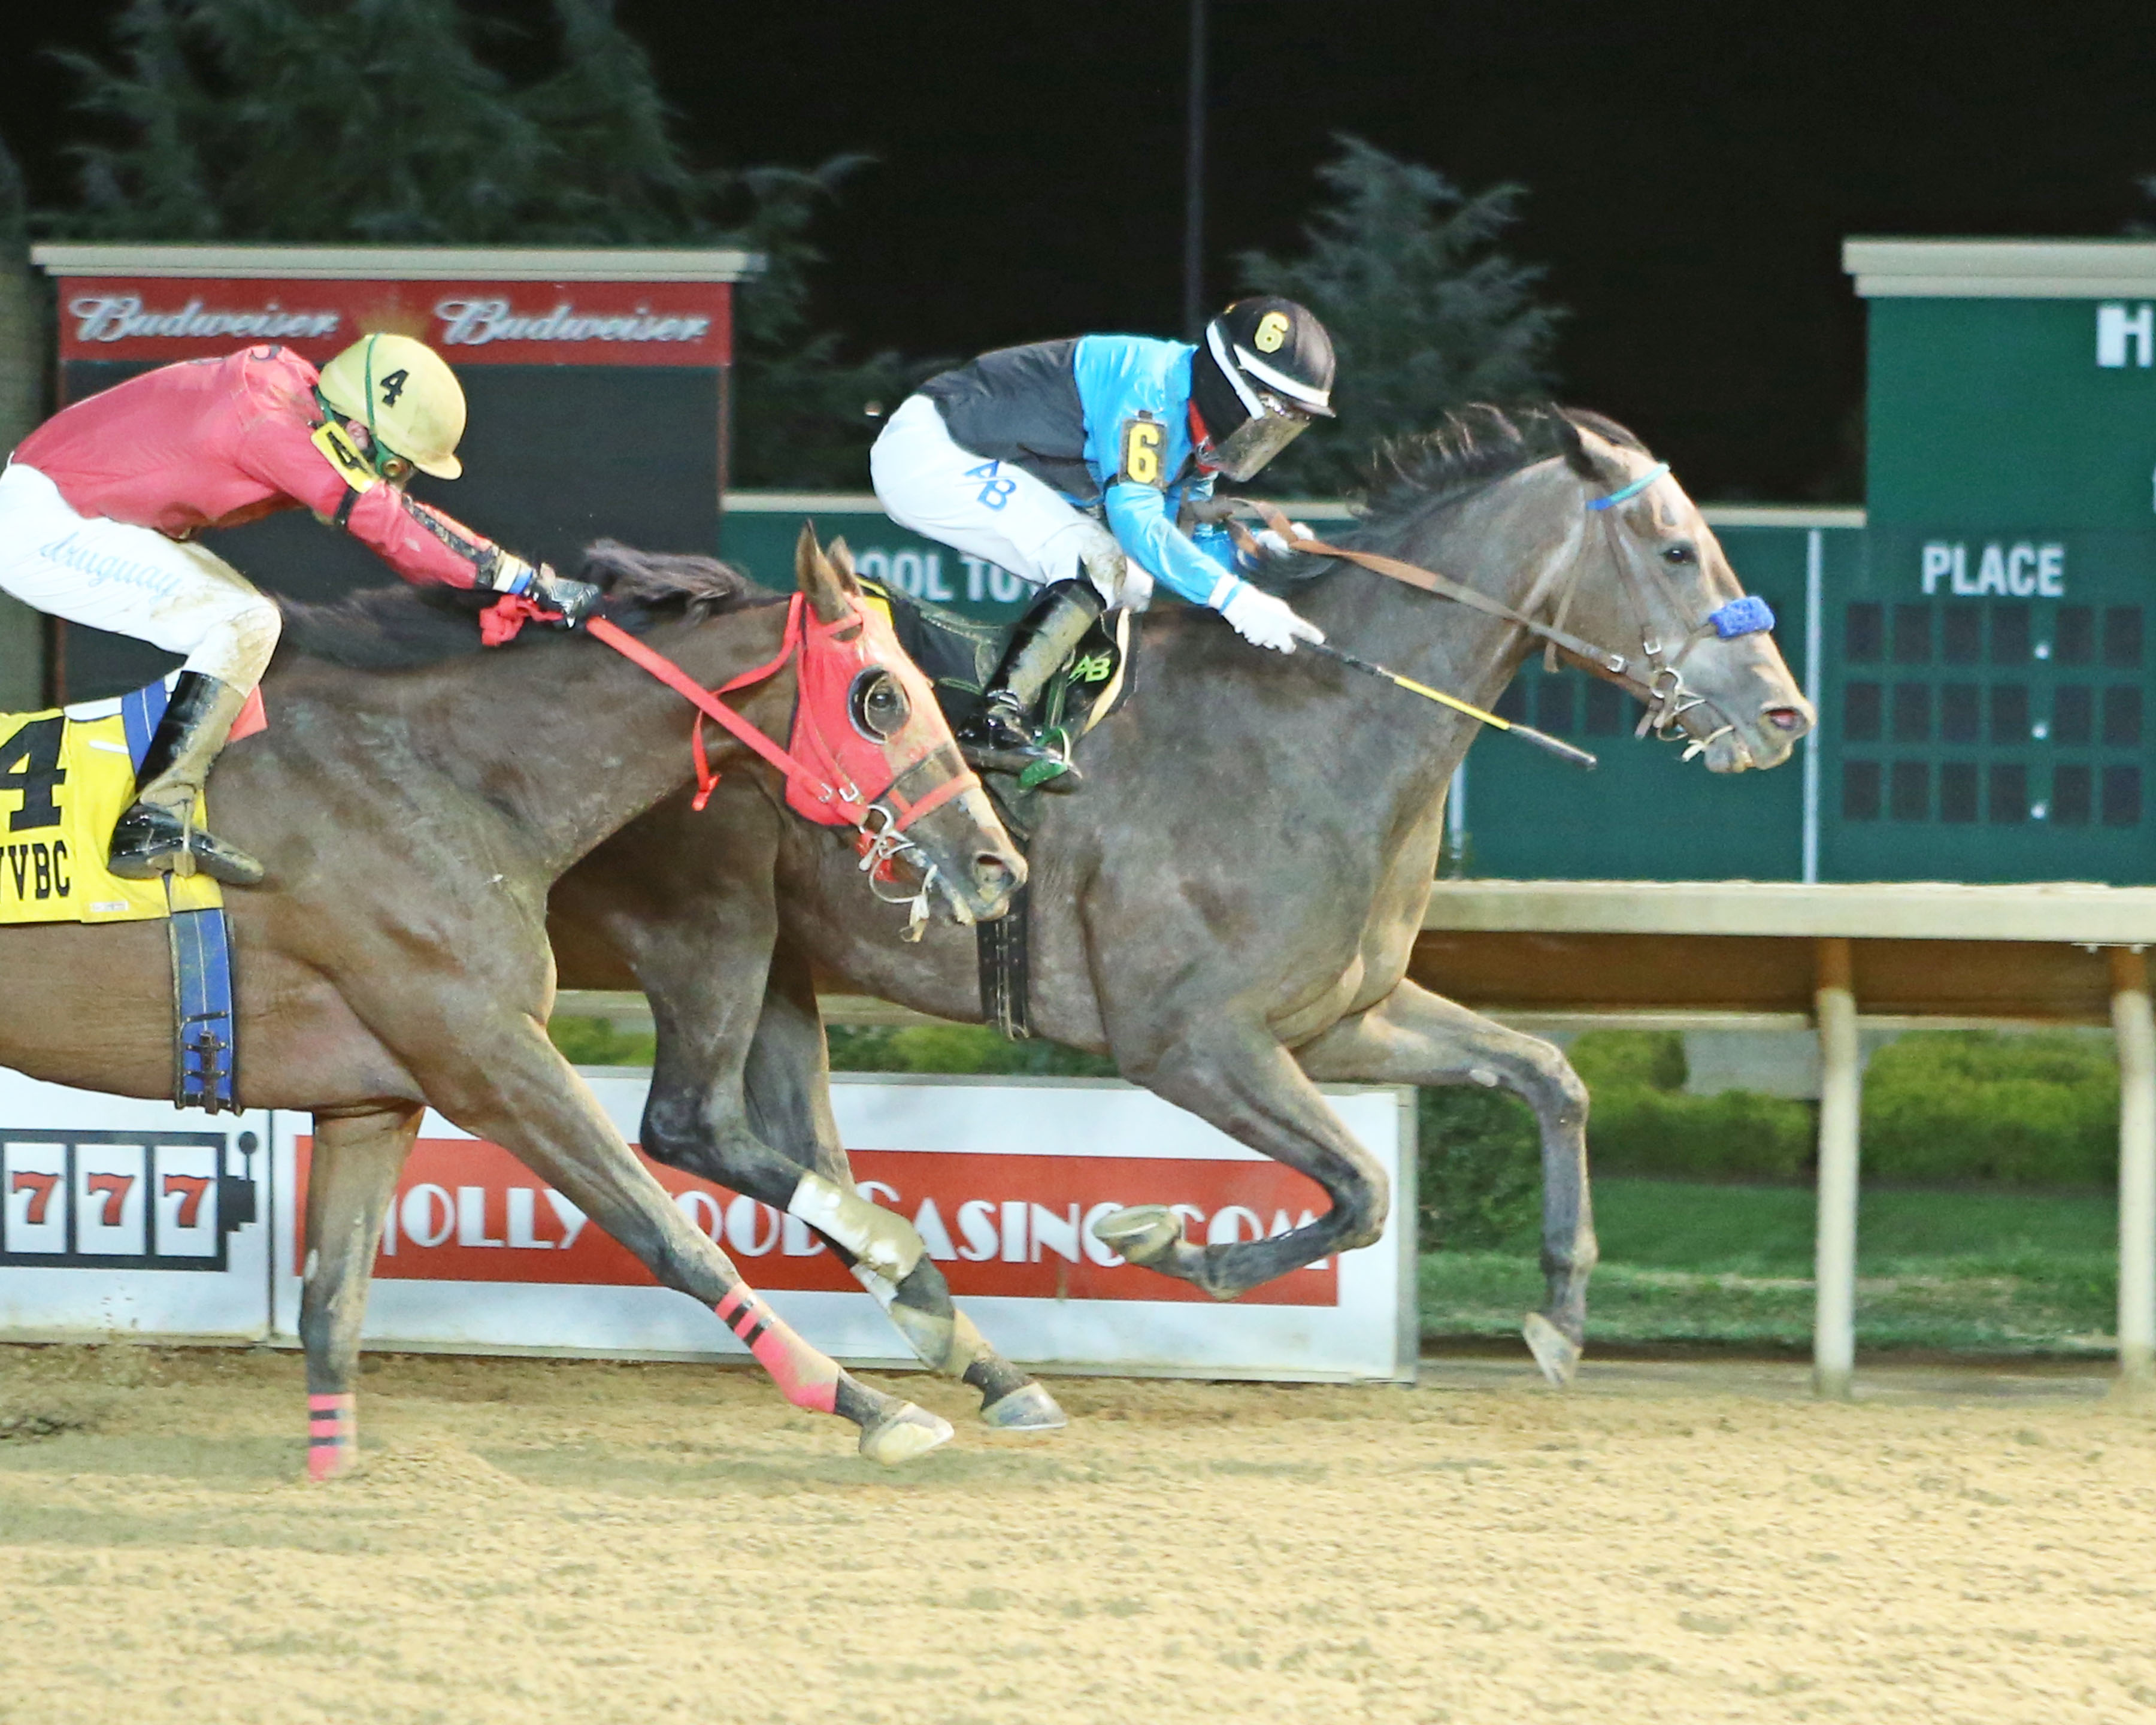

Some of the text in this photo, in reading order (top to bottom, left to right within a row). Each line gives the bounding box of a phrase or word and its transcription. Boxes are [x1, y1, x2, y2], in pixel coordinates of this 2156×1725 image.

[68, 296, 340, 343] Budweiser
[434, 299, 711, 346] Budweiser
[1254, 311, 1289, 353] 6
[380, 368, 410, 408] 4
[326, 430, 368, 470] 4
[1127, 422, 1159, 485] 6
[962, 459, 1017, 512] AB
[854, 550, 953, 601] OOL
[1922, 544, 2065, 597] PLACE
[1067, 653, 1112, 683] AB
[0, 716, 66, 831] 4
[0, 840, 70, 900] VBC
